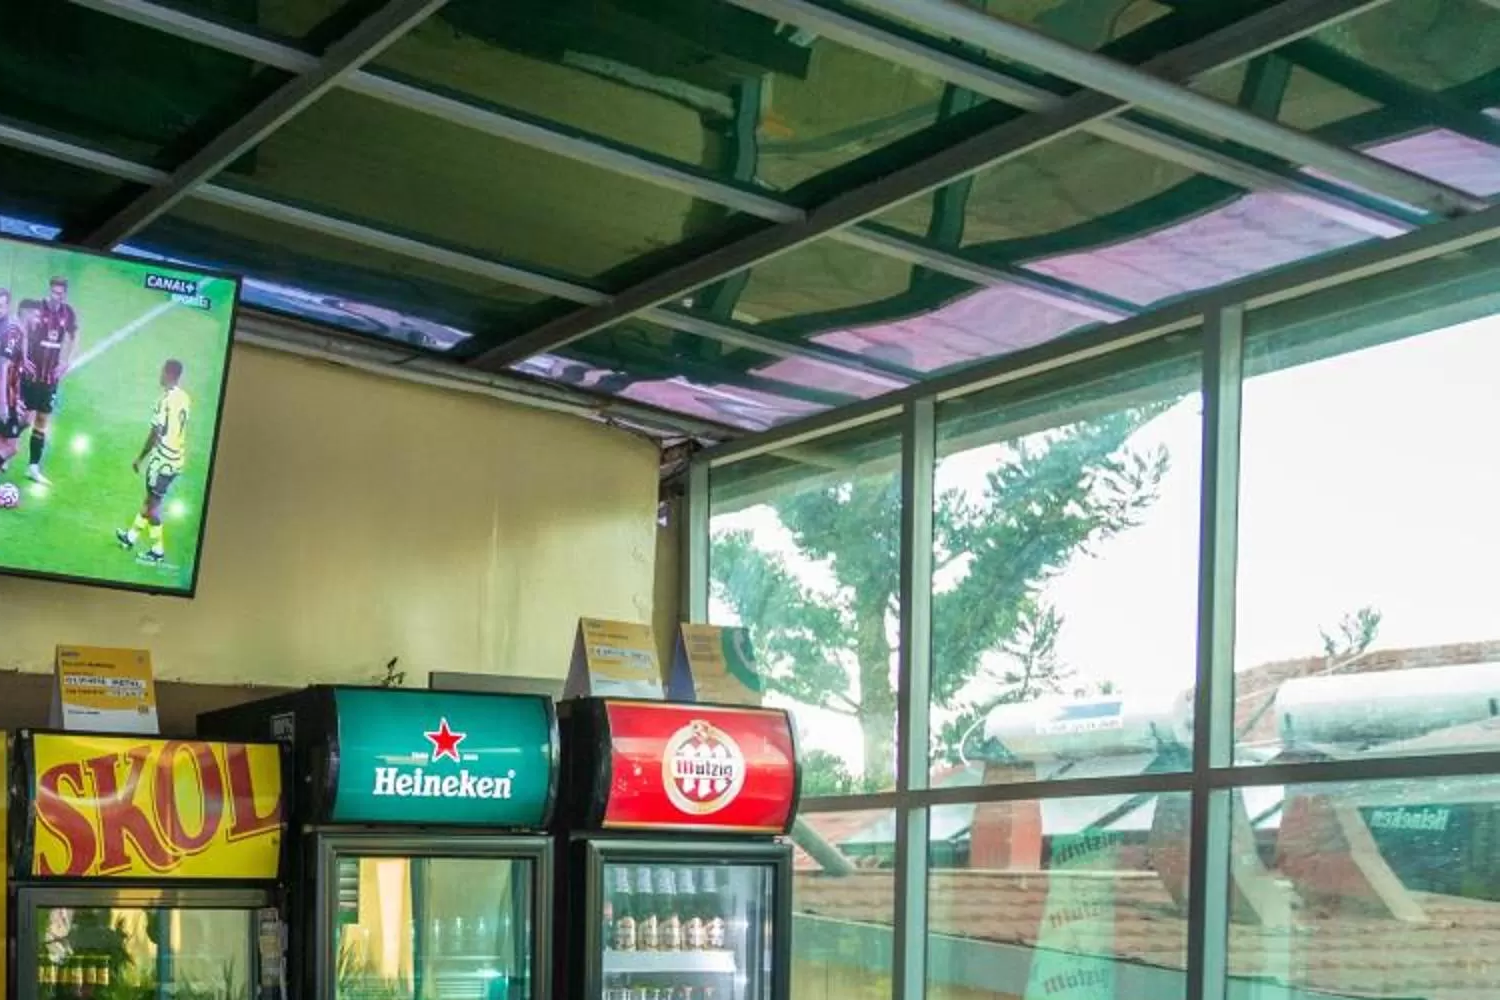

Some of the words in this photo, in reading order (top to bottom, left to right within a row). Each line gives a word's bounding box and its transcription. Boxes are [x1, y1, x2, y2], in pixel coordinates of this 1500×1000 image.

[147, 275, 196, 294] CANAL+
[373, 767, 512, 799] Heineken
[35, 741, 286, 876] SKOL
